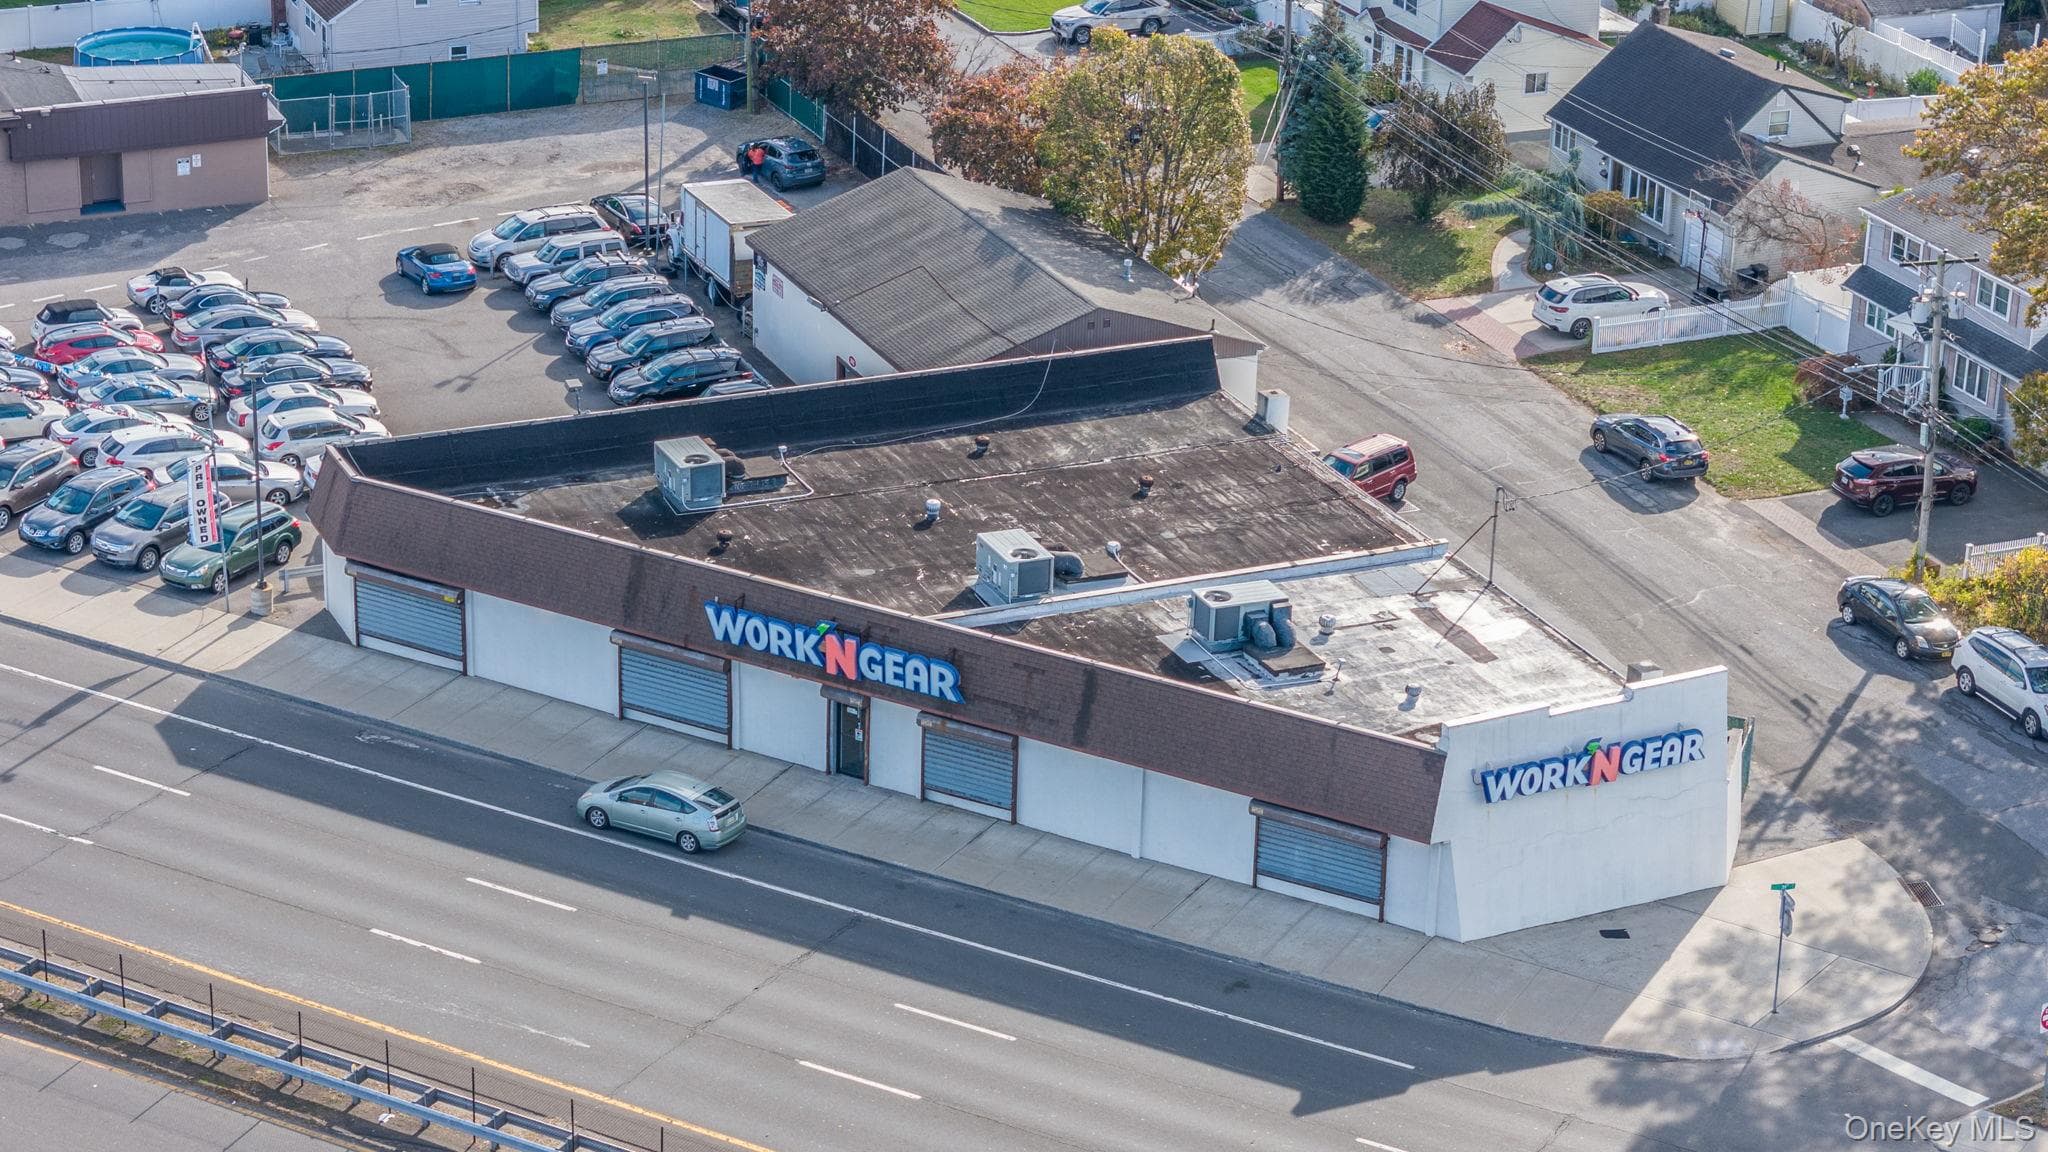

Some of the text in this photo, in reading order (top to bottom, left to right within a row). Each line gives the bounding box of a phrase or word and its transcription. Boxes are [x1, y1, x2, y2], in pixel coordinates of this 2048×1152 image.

[195, 464, 208, 543] PRE OWNED
[704, 602, 824, 667] WORK
[858, 643, 964, 704] GEAR
[1482, 753, 1593, 803] WORK
[1619, 729, 1704, 775] GEAR
